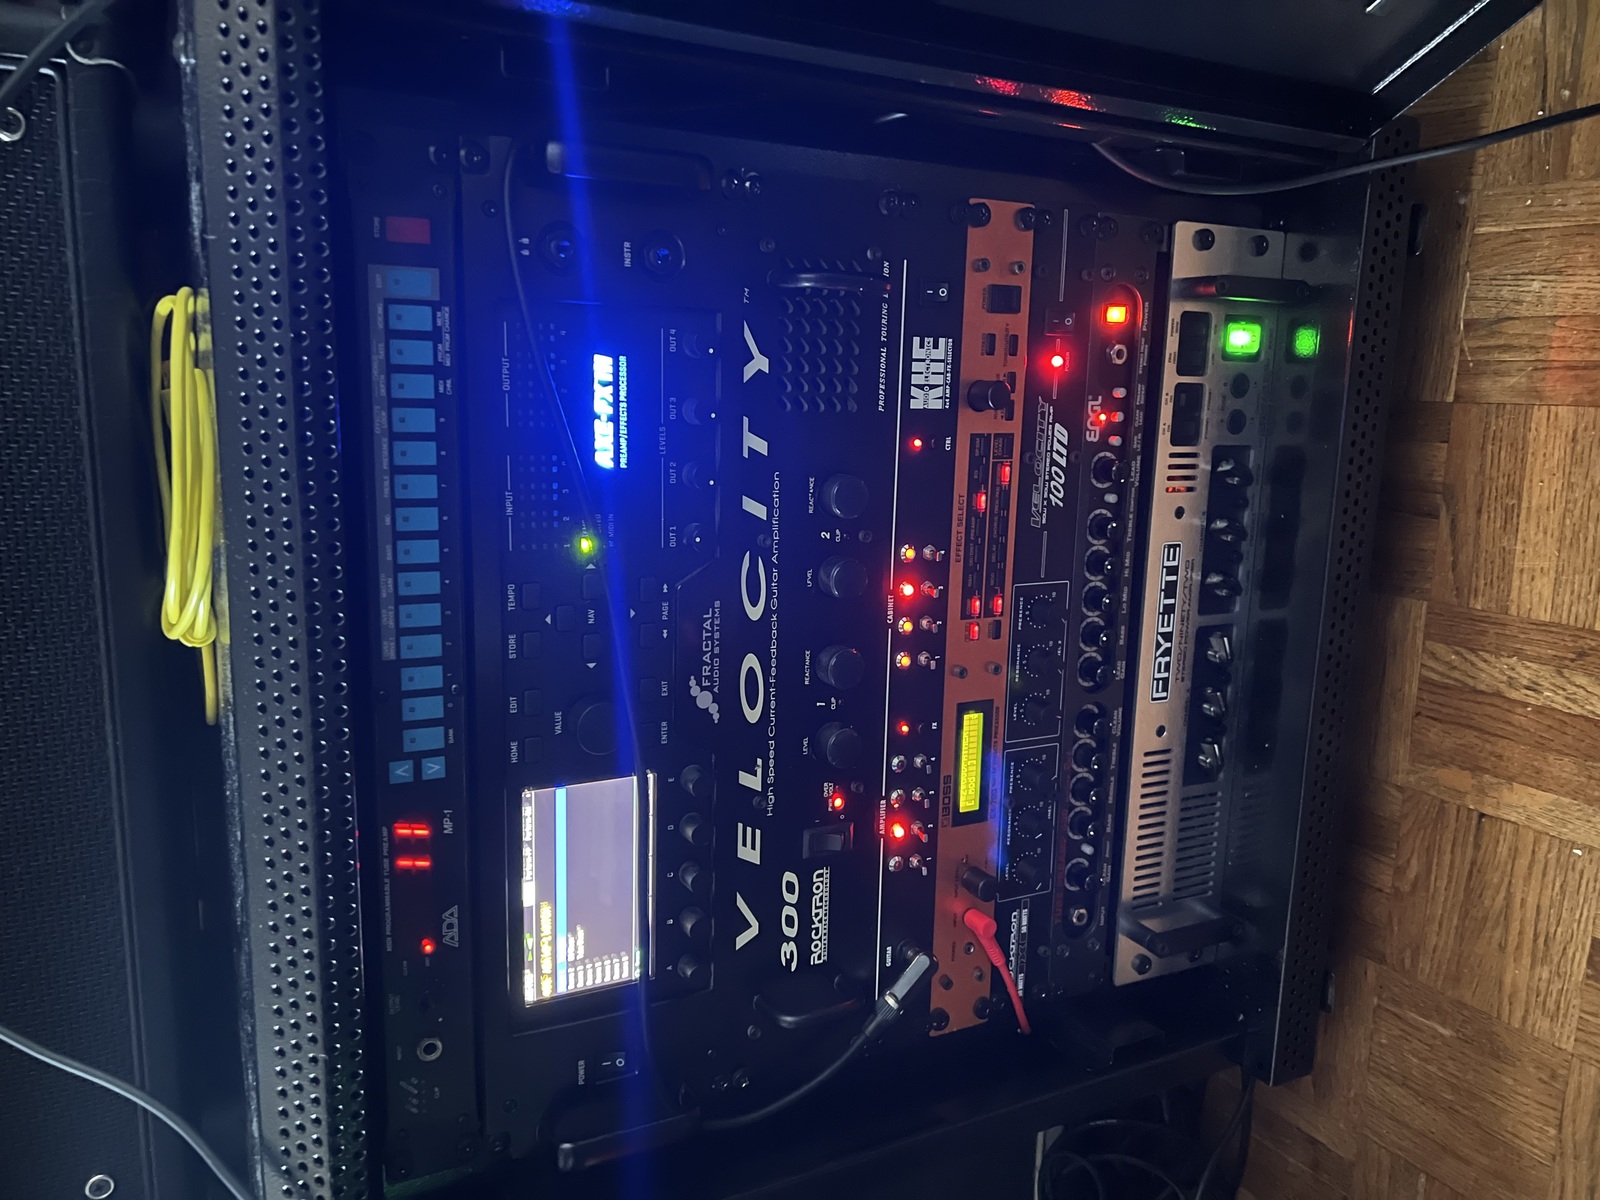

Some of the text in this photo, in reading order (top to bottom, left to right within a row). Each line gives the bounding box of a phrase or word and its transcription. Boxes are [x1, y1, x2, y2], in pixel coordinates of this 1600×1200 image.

[624, 242, 632, 267] INSTR
[1142, 301, 1150, 332] POWER
[669, 328, 677, 352] OUT 4
[877, 303, 888, 412] PROFESSIONAL TOURING
[502, 357, 511, 390] OUTPUT
[909, 336, 946, 410] KHE
[618, 356, 628, 468] PREAMP/EFFECTS PROCESSOR
[1086, 396, 1102, 442] ENGL
[658, 426, 666, 454] LEVELS
[944, 436, 952, 451] CTRL
[1030, 396, 1046, 528] VELOCITY
[1049, 422, 1069, 508] 100 LTD
[1134, 454, 1142, 487] VOLUME
[505, 490, 514, 516] INPUT
[608, 514, 614, 522] IN
[955, 494, 965, 562] EFFECT SELECT
[1126, 513, 1134, 542] TREBLE
[820, 531, 831, 540] 2
[834, 528, 842, 542] CLIP
[1124, 550, 1132, 566] MID
[508, 584, 516, 610] TEMPO
[886, 594, 894, 624] CABINET
[588, 608, 596, 624] NAV
[714, 600, 722, 654] SYSTEMS
[1152, 544, 1180, 699] FRYETTE
[1174, 559, 1190, 683] TWO/NINETY/TWO
[508, 634, 516, 659] STORE
[702, 608, 712, 686] FRACTAL
[736, 319, 770, 951] VELOCITY
[766, 471, 781, 816] High Speed Current-Feedback Guitar Amplification
[1118, 624, 1126, 646] BASS
[1114, 660, 1122, 680] LEAD
[510, 696, 518, 713] EDIT
[554, 711, 562, 734] VALUE
[931, 721, 938, 730] FX
[510, 740, 518, 763] HOME
[1110, 742, 1118, 770] TREBLE
[942, 774, 952, 817] BOSS
[443, 809, 454, 834] MP-1
[879, 799, 887, 834] AMPLIFIER
[382, 860, 390, 876] TUBE
[384, 878, 392, 936] PROGRAMMABLE
[780, 870, 800, 972] 300
[810, 868, 824, 966] ROCKTRON
[442, 904, 459, 948] ADA
[578, 1060, 586, 1085] POWER
